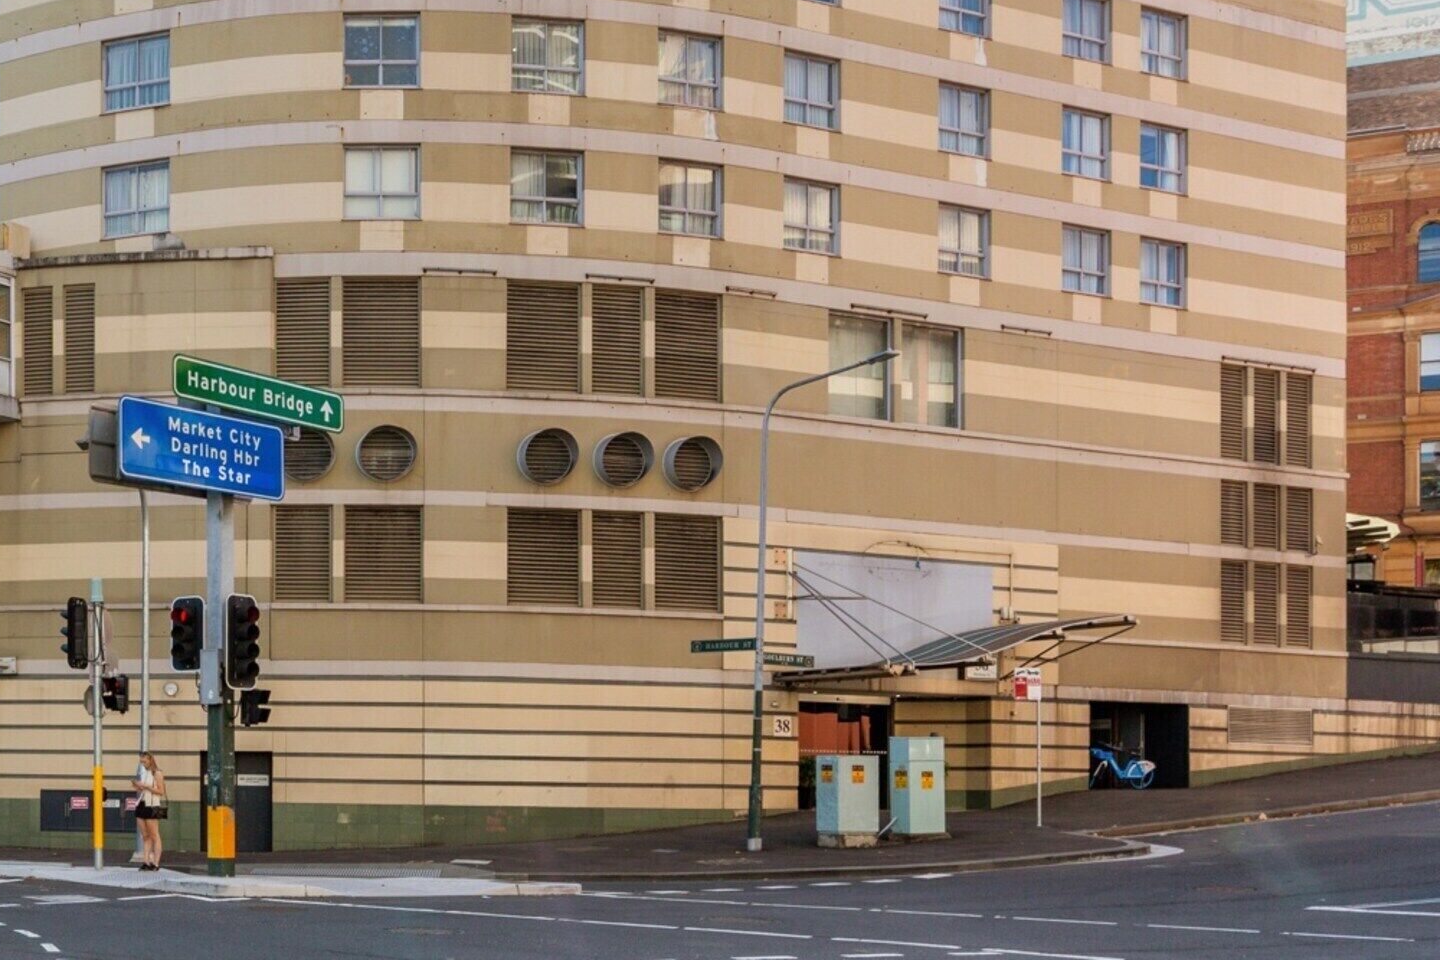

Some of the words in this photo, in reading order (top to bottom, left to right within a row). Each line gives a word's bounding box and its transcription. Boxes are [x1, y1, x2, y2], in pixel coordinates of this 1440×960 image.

[187, 370, 255, 401] Harbour
[263, 389, 313, 418] Bridge
[168, 416, 222, 440] Market
[229, 429, 261, 449] City
[171, 438, 227, 465] Darling
[233, 449, 260, 467] Hbr
[182, 459, 210, 477] The
[218, 466, 251, 485] Star
[774, 719, 791, 733] 38
